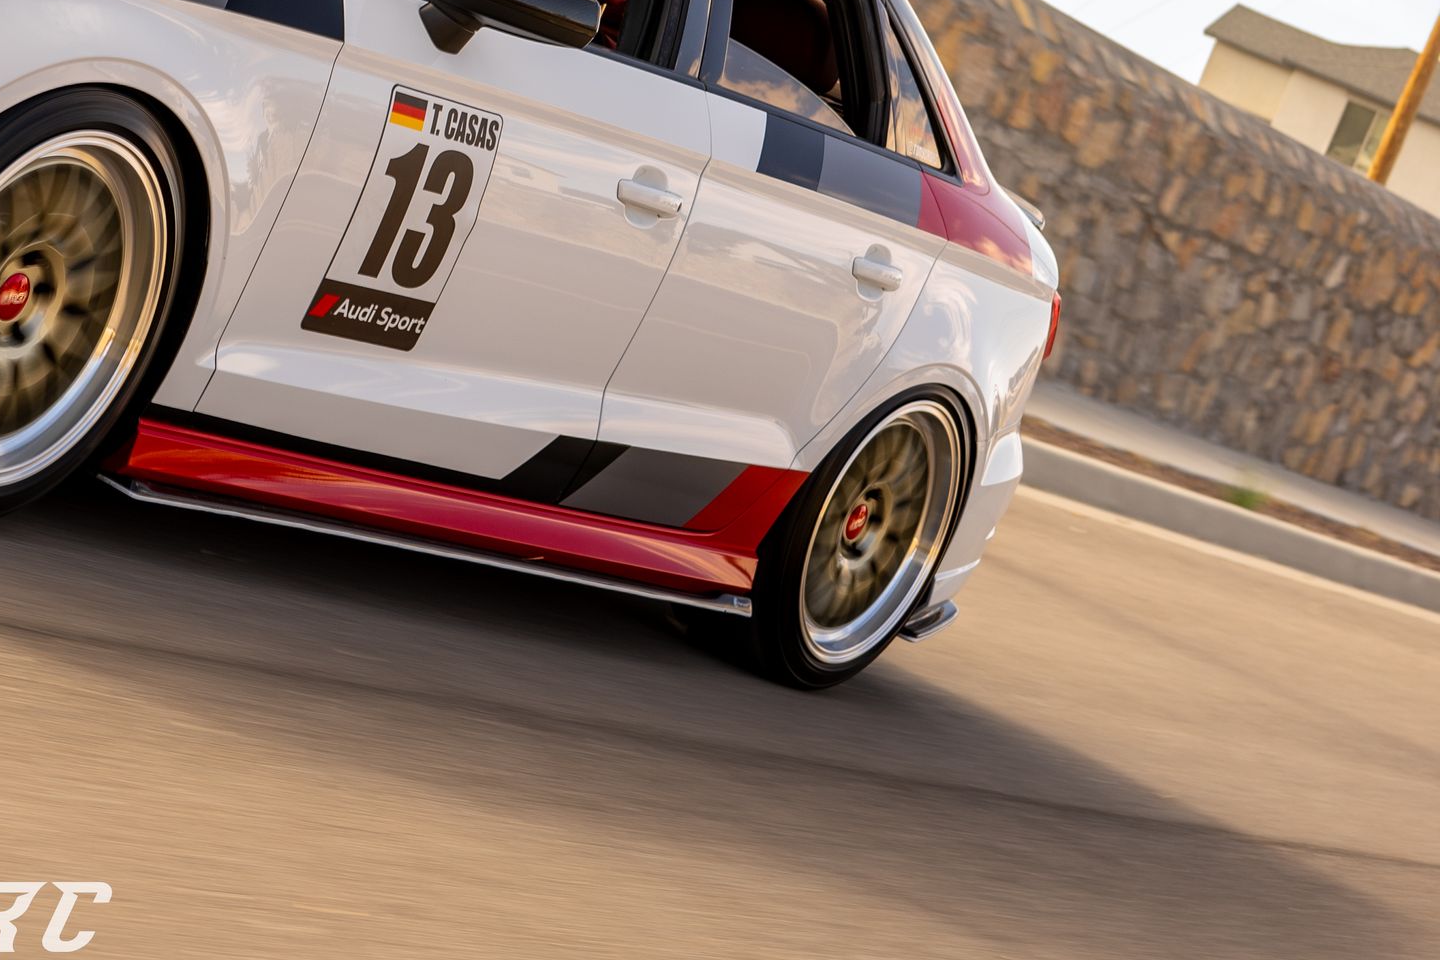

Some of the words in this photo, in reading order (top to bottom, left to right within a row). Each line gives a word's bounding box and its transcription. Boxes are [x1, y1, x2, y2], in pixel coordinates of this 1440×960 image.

[430, 103, 443, 137] T.
[444, 108, 499, 151] CASAS
[358, 142, 474, 289] 13
[334, 298, 378, 323] Audi
[377, 307, 426, 334] Sport
